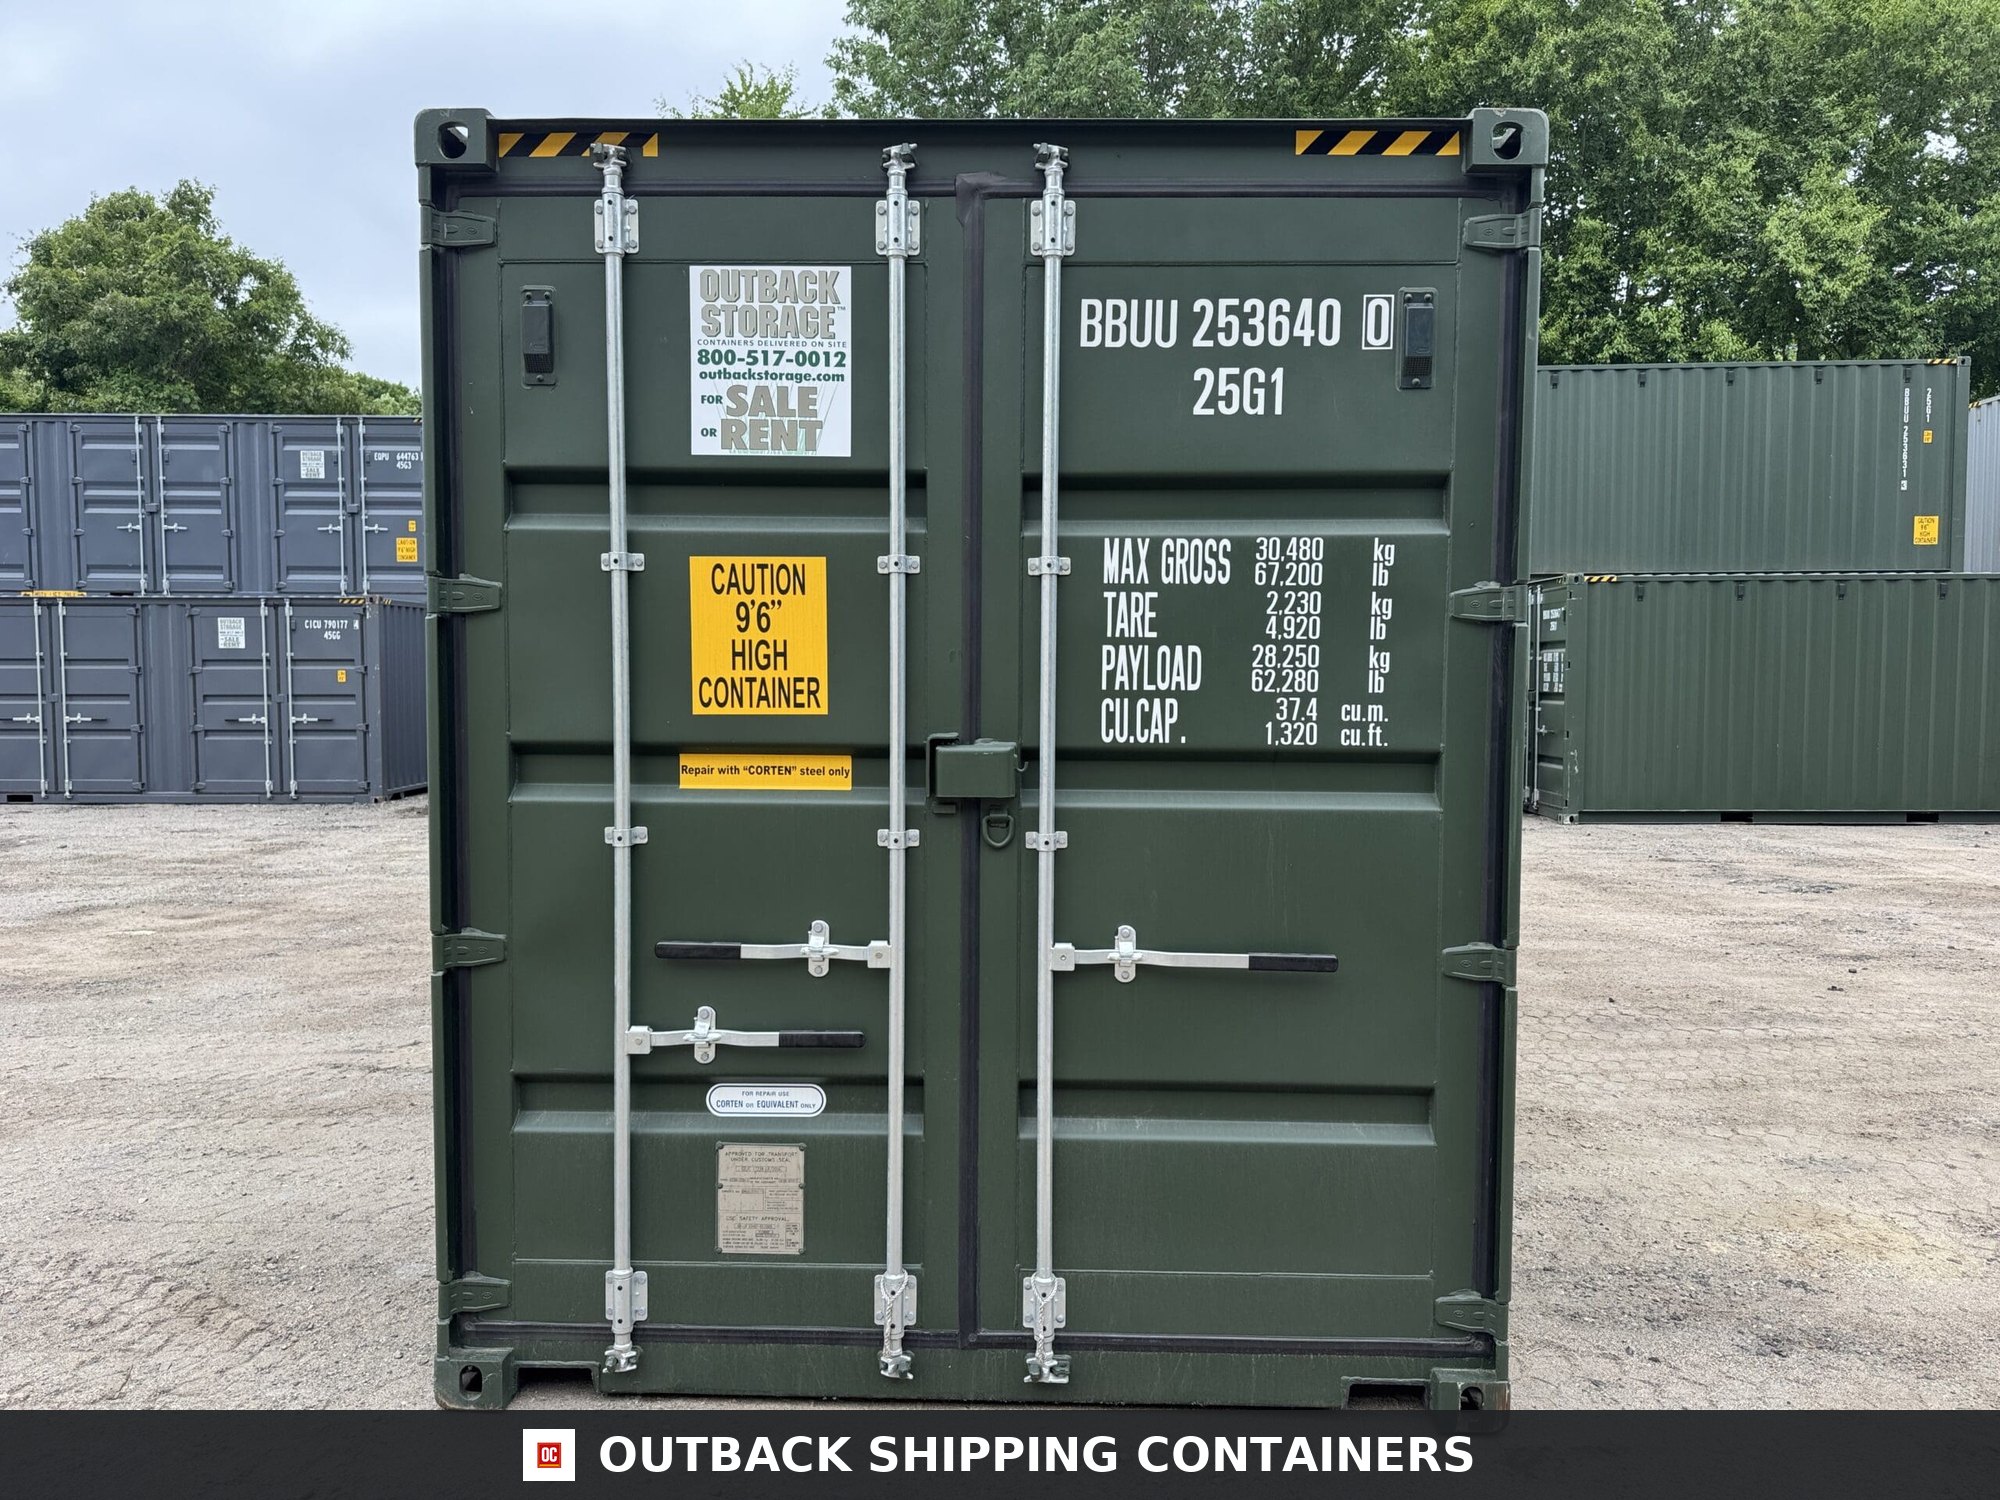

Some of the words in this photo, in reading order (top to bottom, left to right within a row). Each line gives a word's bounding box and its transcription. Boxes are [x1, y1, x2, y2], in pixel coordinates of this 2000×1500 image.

[700, 269, 841, 304] OUTBACK
[1080, 298, 1178, 348] BBUU
[1192, 298, 1342, 347] 253640
[1365, 297, 1391, 347] 0
[697, 339, 754, 347] CONTAINERS
[758, 339, 807, 347] DELIVERED
[697, 349, 846, 368] 800-517-0012
[699, 368, 845, 383] outbackstorage.com
[700, 395, 723, 405] FOR
[726, 385, 818, 418] SALE
[1193, 367, 1284, 416] 25G1
[700, 428, 717, 437] OR
[720, 419, 823, 451] RENT
[1103, 537, 1150, 584] MAX
[1161, 538, 1231, 585] GROSS
[1255, 537, 1324, 562] 30,480
[1373, 537, 1395, 567] kg
[711, 563, 806, 595] CAUTION
[1254, 562, 1323, 586] 67,200
[1372, 562, 1389, 586] lb
[1103, 591, 1158, 638] TARE
[1266, 591, 1322, 616] 2,230
[1370, 591, 1393, 620] kg
[1265, 615, 1320, 640] 4,920
[1370, 616, 1386, 640] lb
[731, 639, 788, 671] HIGH
[1101, 645, 1202, 691] PAYLOAD
[1251, 644, 1320, 669] 28,250
[1368, 645, 1391, 674] kg
[698, 676, 821, 709] CONTAINER
[1251, 669, 1319, 694] 62,280
[1368, 669, 1385, 693] lb
[1275, 697, 1318, 721] 37.4
[1341, 703, 1389, 722] cu.m.
[1265, 721, 1318, 747] 1,320
[1340, 722, 1388, 747] cu.ft.
[681, 765, 715, 777] Repair
[718, 765, 740, 775] with
[800, 766, 825, 776] steel
[828, 767, 850, 779] only
[716, 1100, 743, 1108] CORTEN
[757, 1100, 799, 1109] EQUIVALENT
